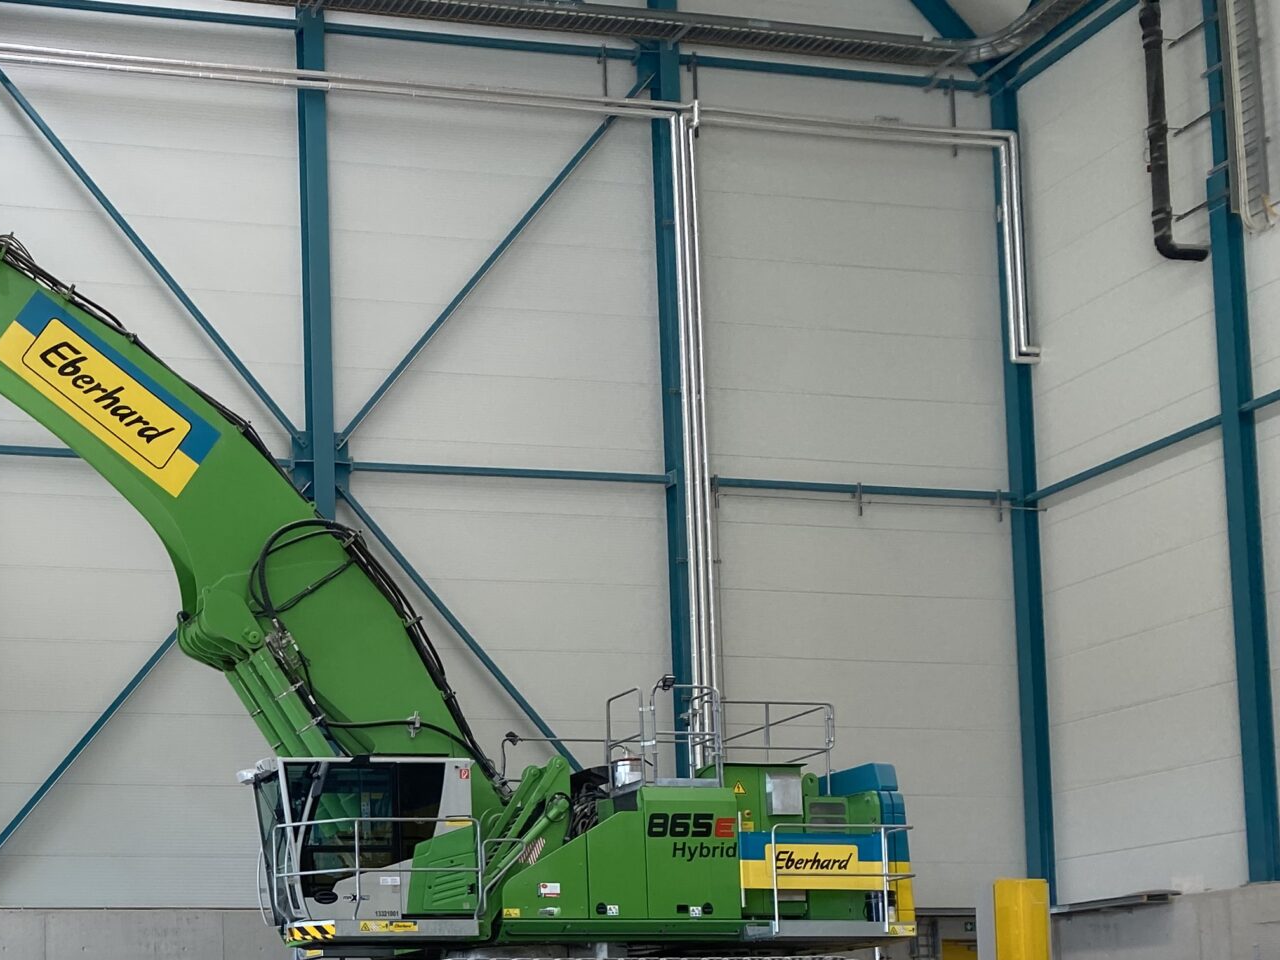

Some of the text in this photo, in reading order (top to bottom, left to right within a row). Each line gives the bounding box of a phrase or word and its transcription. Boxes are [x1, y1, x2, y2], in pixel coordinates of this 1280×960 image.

[39, 341, 176, 445] Eberhard
[647, 812, 737, 838] 865E
[672, 841, 738, 862] Hybrid
[775, 850, 853, 871] Eberhard
